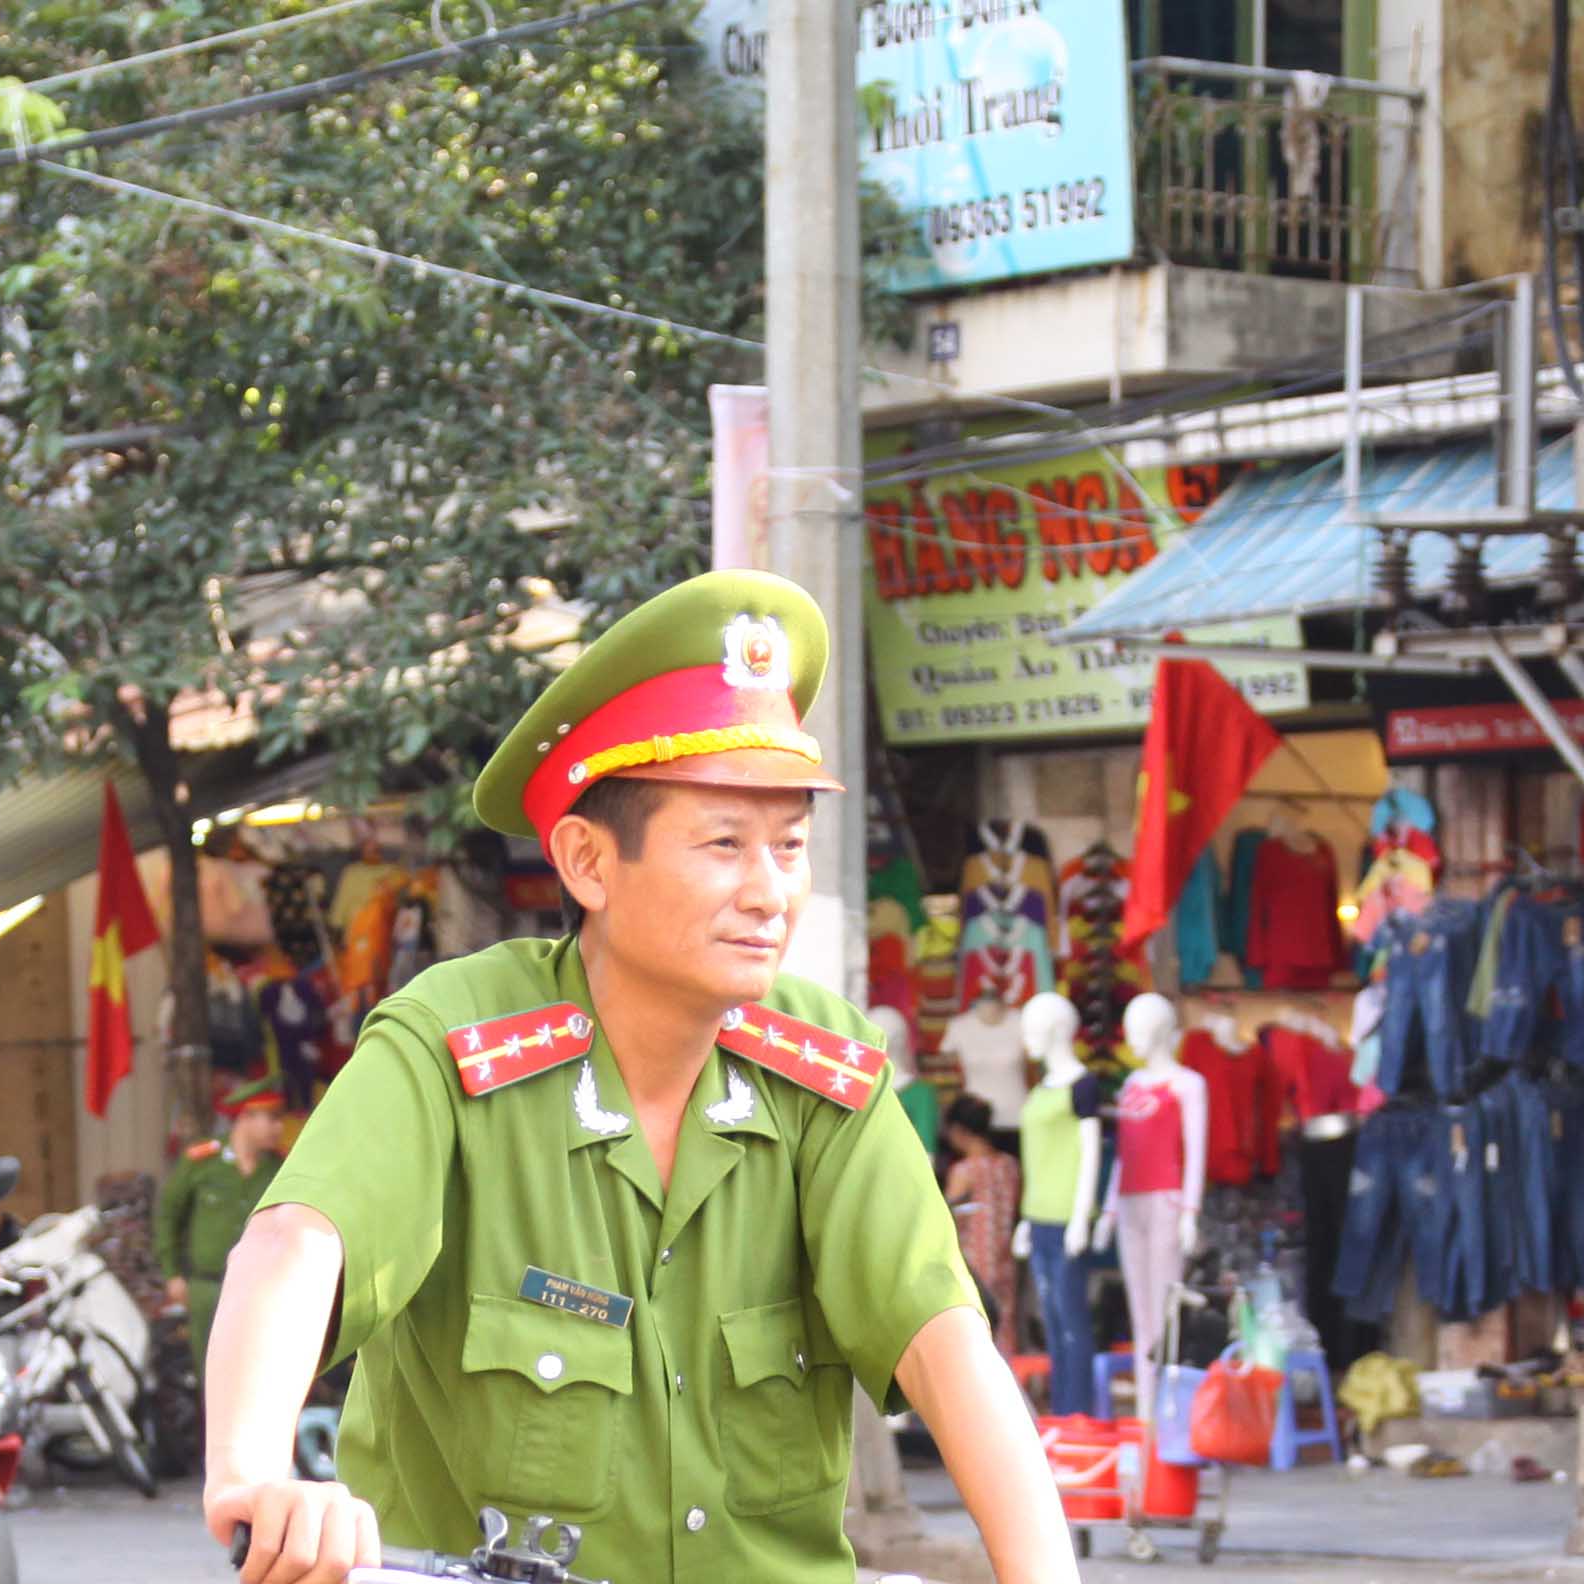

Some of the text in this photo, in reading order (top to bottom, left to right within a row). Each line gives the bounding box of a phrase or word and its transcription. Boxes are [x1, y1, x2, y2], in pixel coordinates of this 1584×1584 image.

[961, 78, 1063, 137] Trang
[1021, 175, 1106, 229] 51992
[541, 1290, 567, 1307] 111
[578, 1302, 609, 1321] 270
